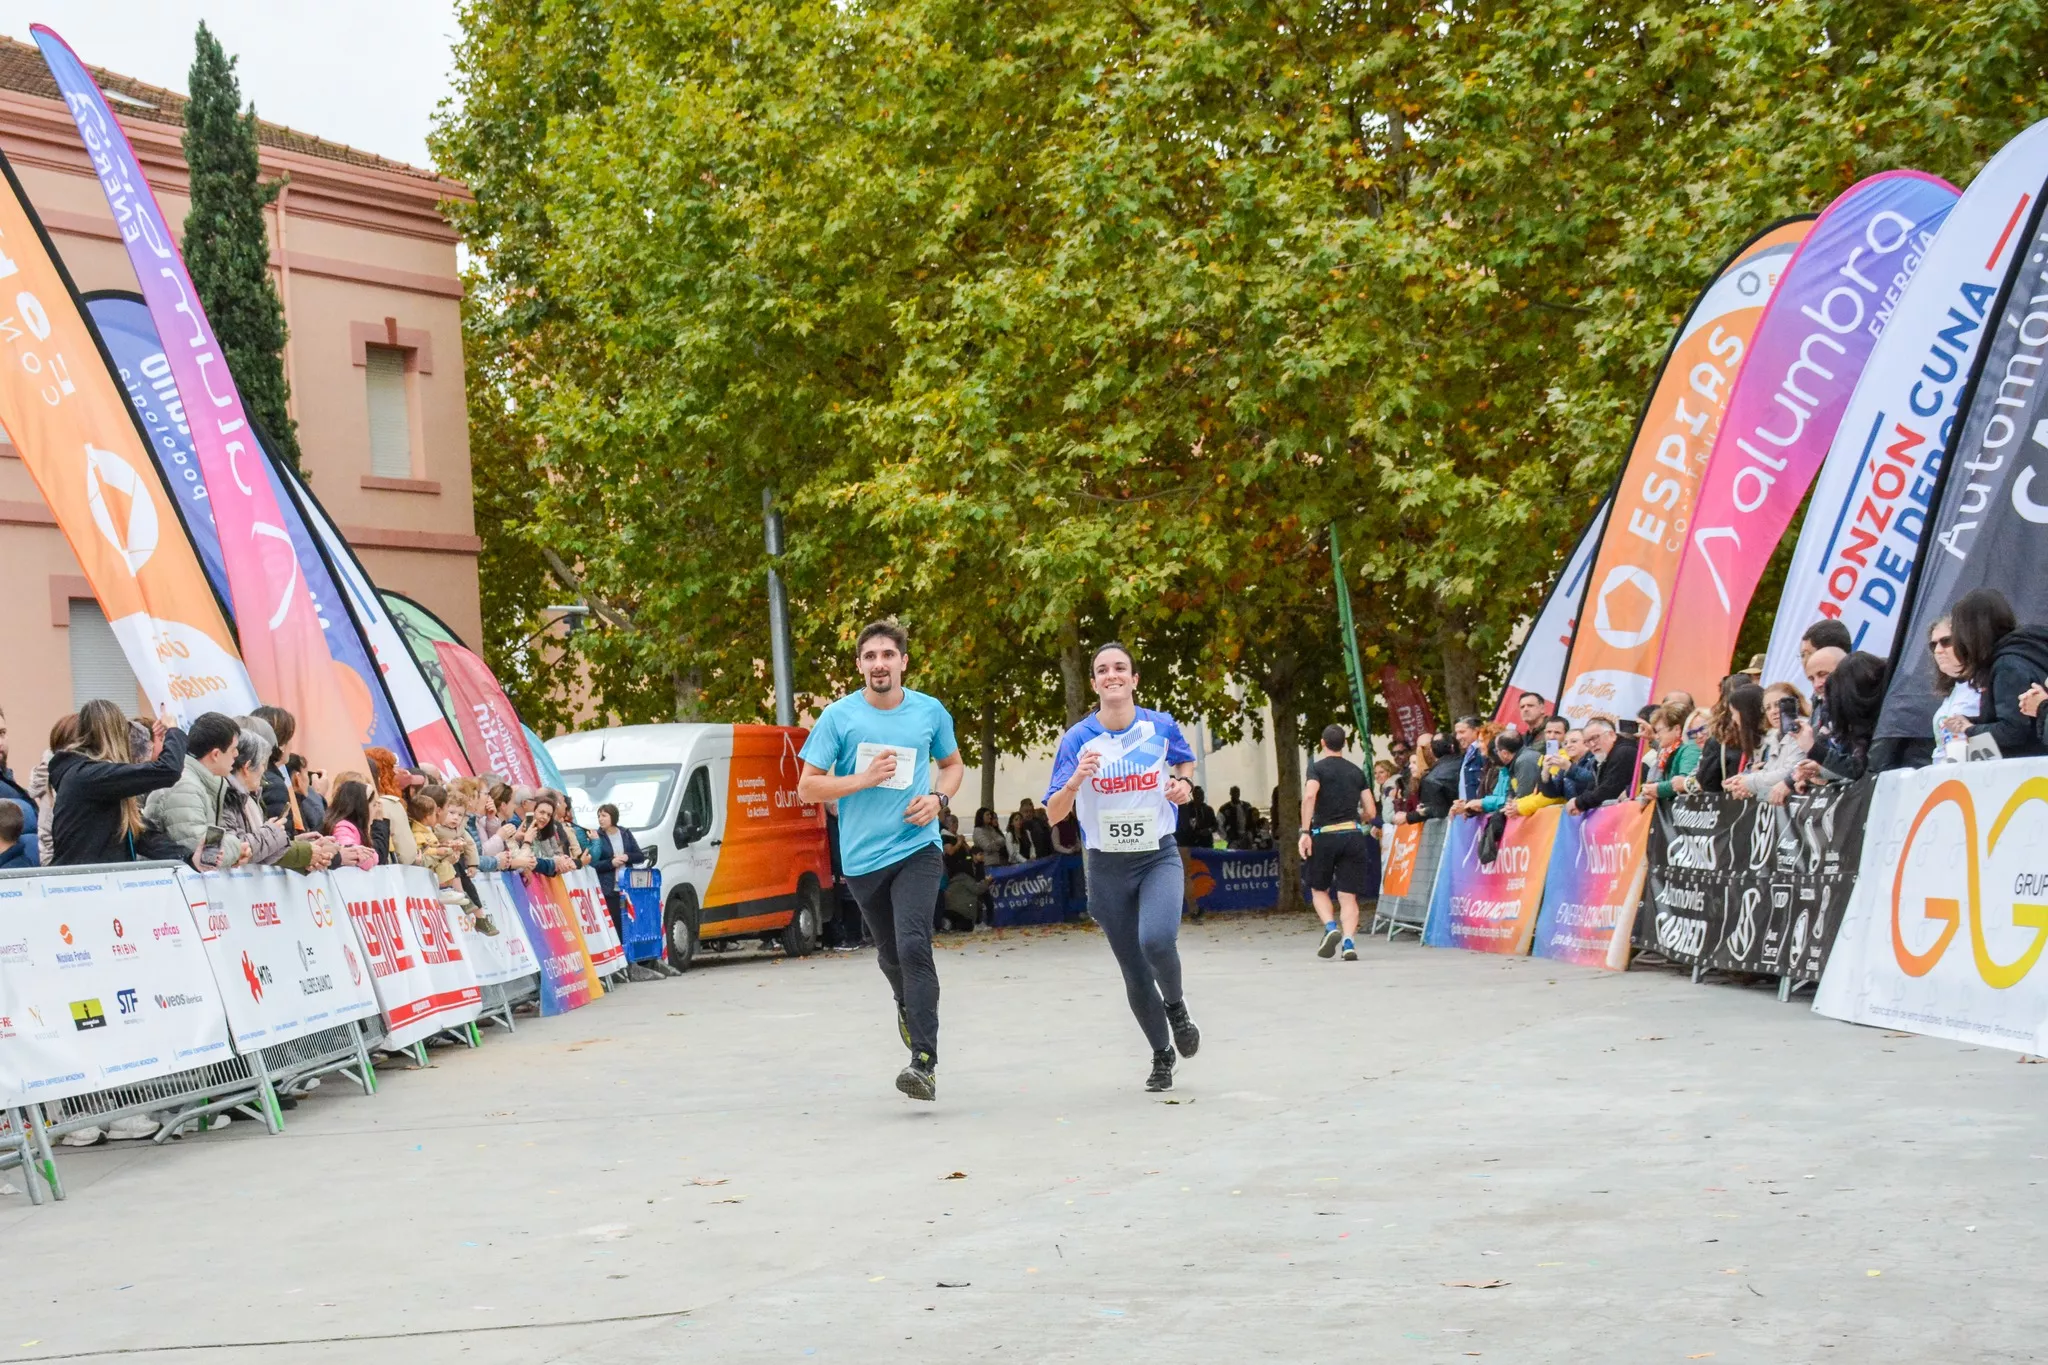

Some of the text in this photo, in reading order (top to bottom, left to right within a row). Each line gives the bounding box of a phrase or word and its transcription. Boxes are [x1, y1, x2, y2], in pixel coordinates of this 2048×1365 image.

[1730, 209, 1916, 514] alumbra
[1909, 281, 1998, 418] CUNA
[1626, 324, 1745, 546] ESPIAS
[1859, 544, 1914, 618] DE
[1109, 822, 1145, 838] 595
[1224, 880, 1269, 891] centro
[116, 988, 139, 1015] STF
